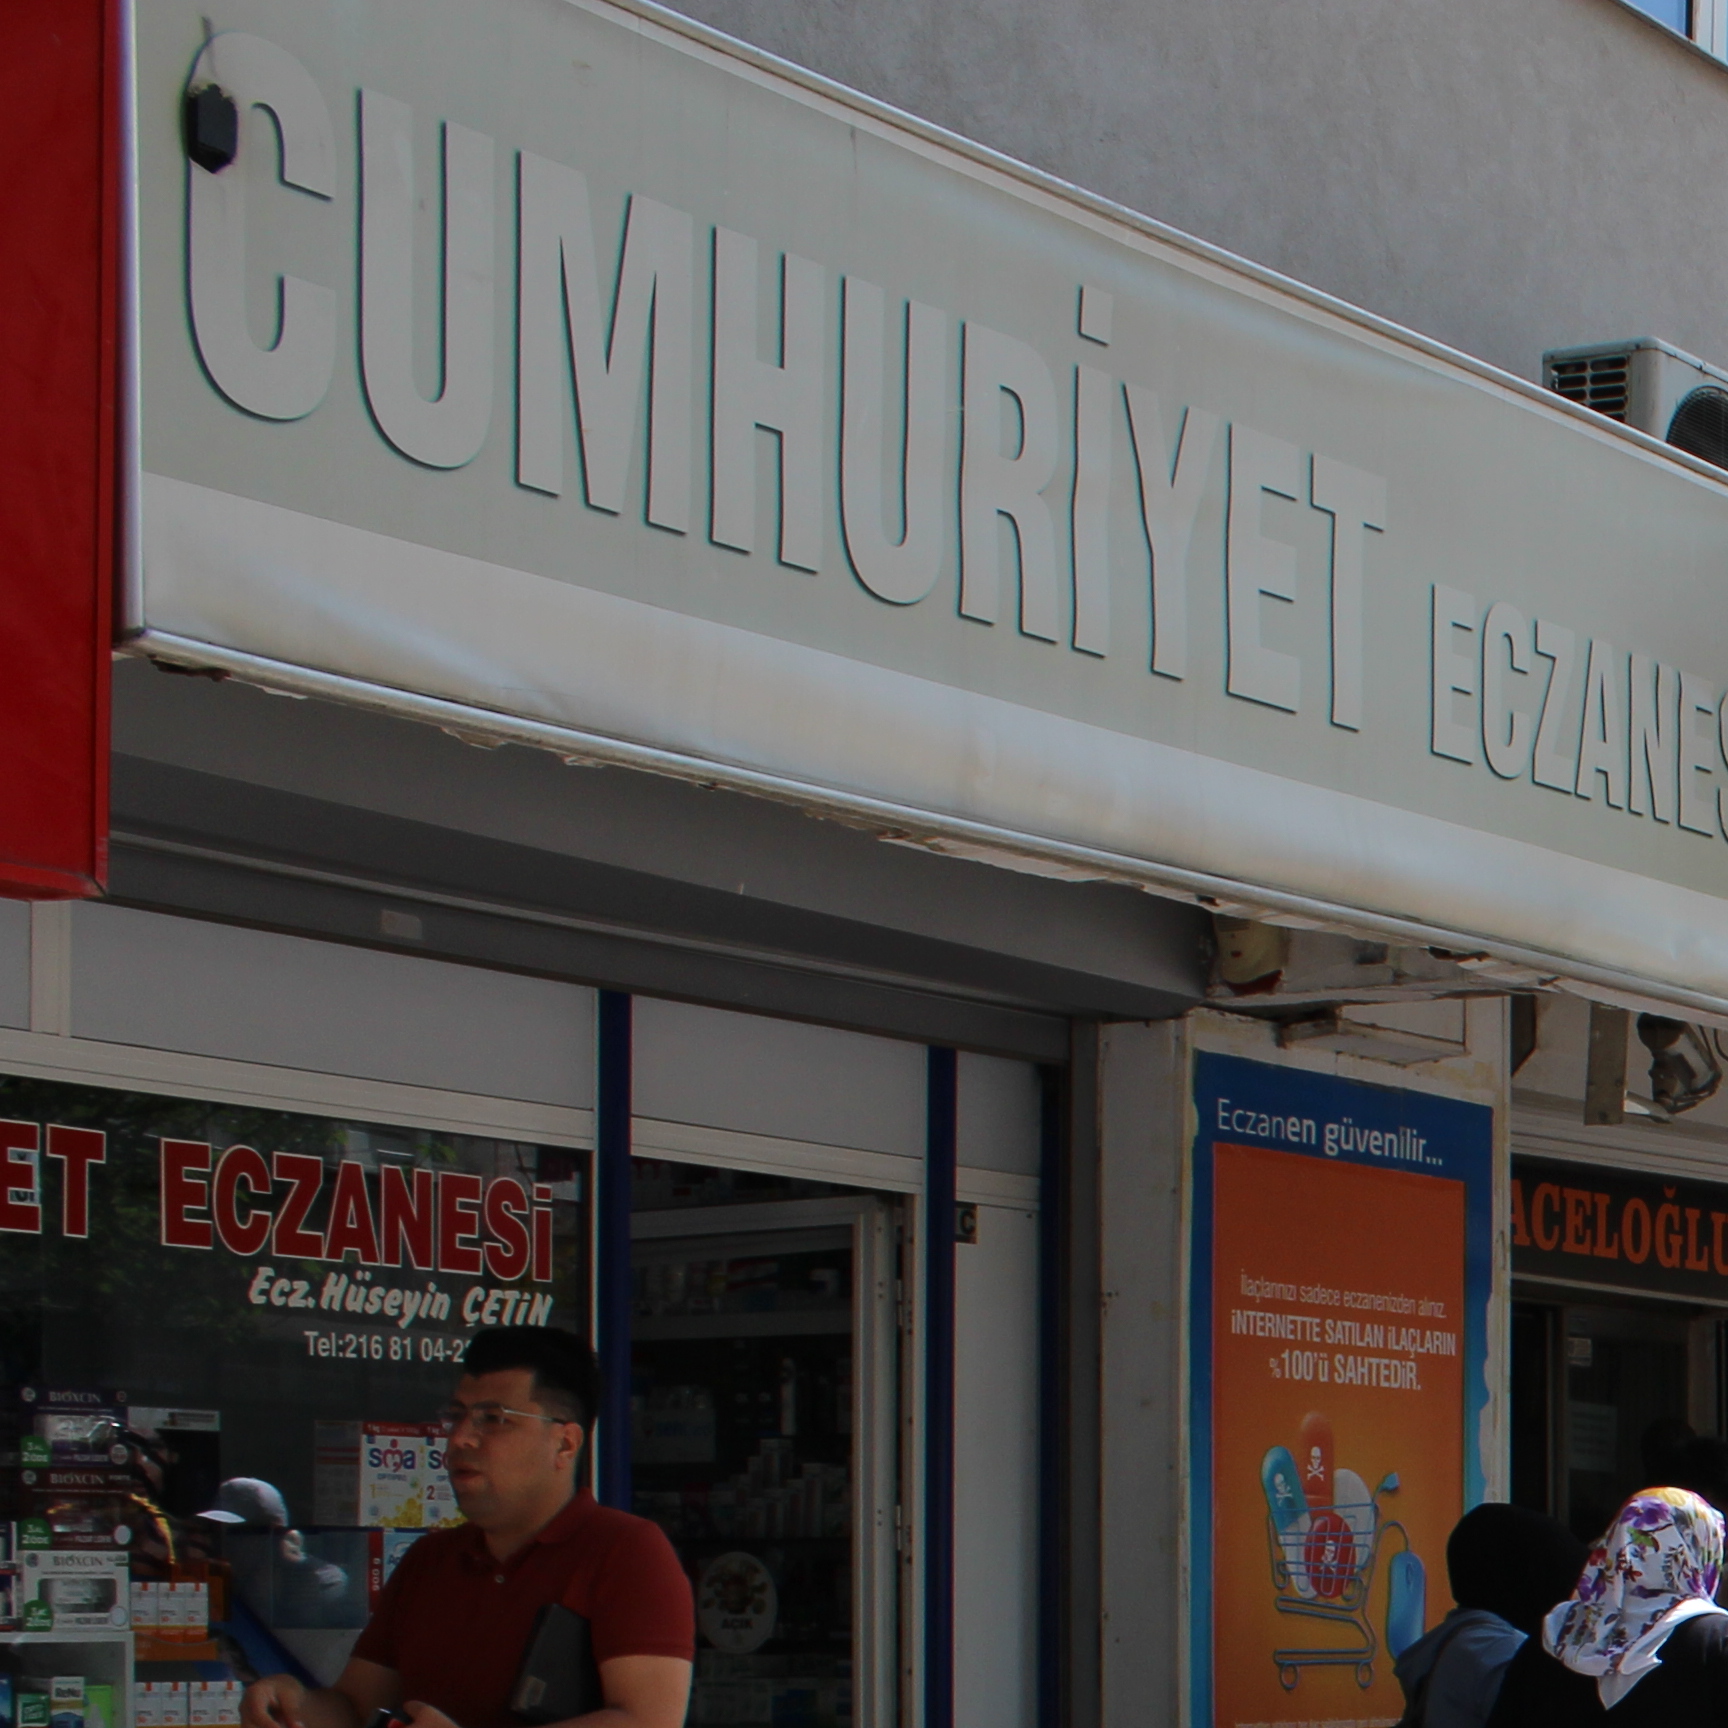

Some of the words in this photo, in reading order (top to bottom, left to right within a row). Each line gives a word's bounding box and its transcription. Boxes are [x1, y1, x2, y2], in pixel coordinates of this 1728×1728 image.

[186, 28, 1388, 733] CUMHURİYET
[1217, 1098, 1316, 1144] Eczanen
[159, 1137, 553, 1283] ECZANESİ
[247, 1266, 316, 1308] Ecz.
[319, 1270, 451, 1329] Hüseyin
[461, 1286, 554, 1328] ÇETİN
[1300, 1284, 1341, 1306] sadece
[390, 1336, 413, 1360] 81
[1325, 1318, 1385, 1349] SATILAN
